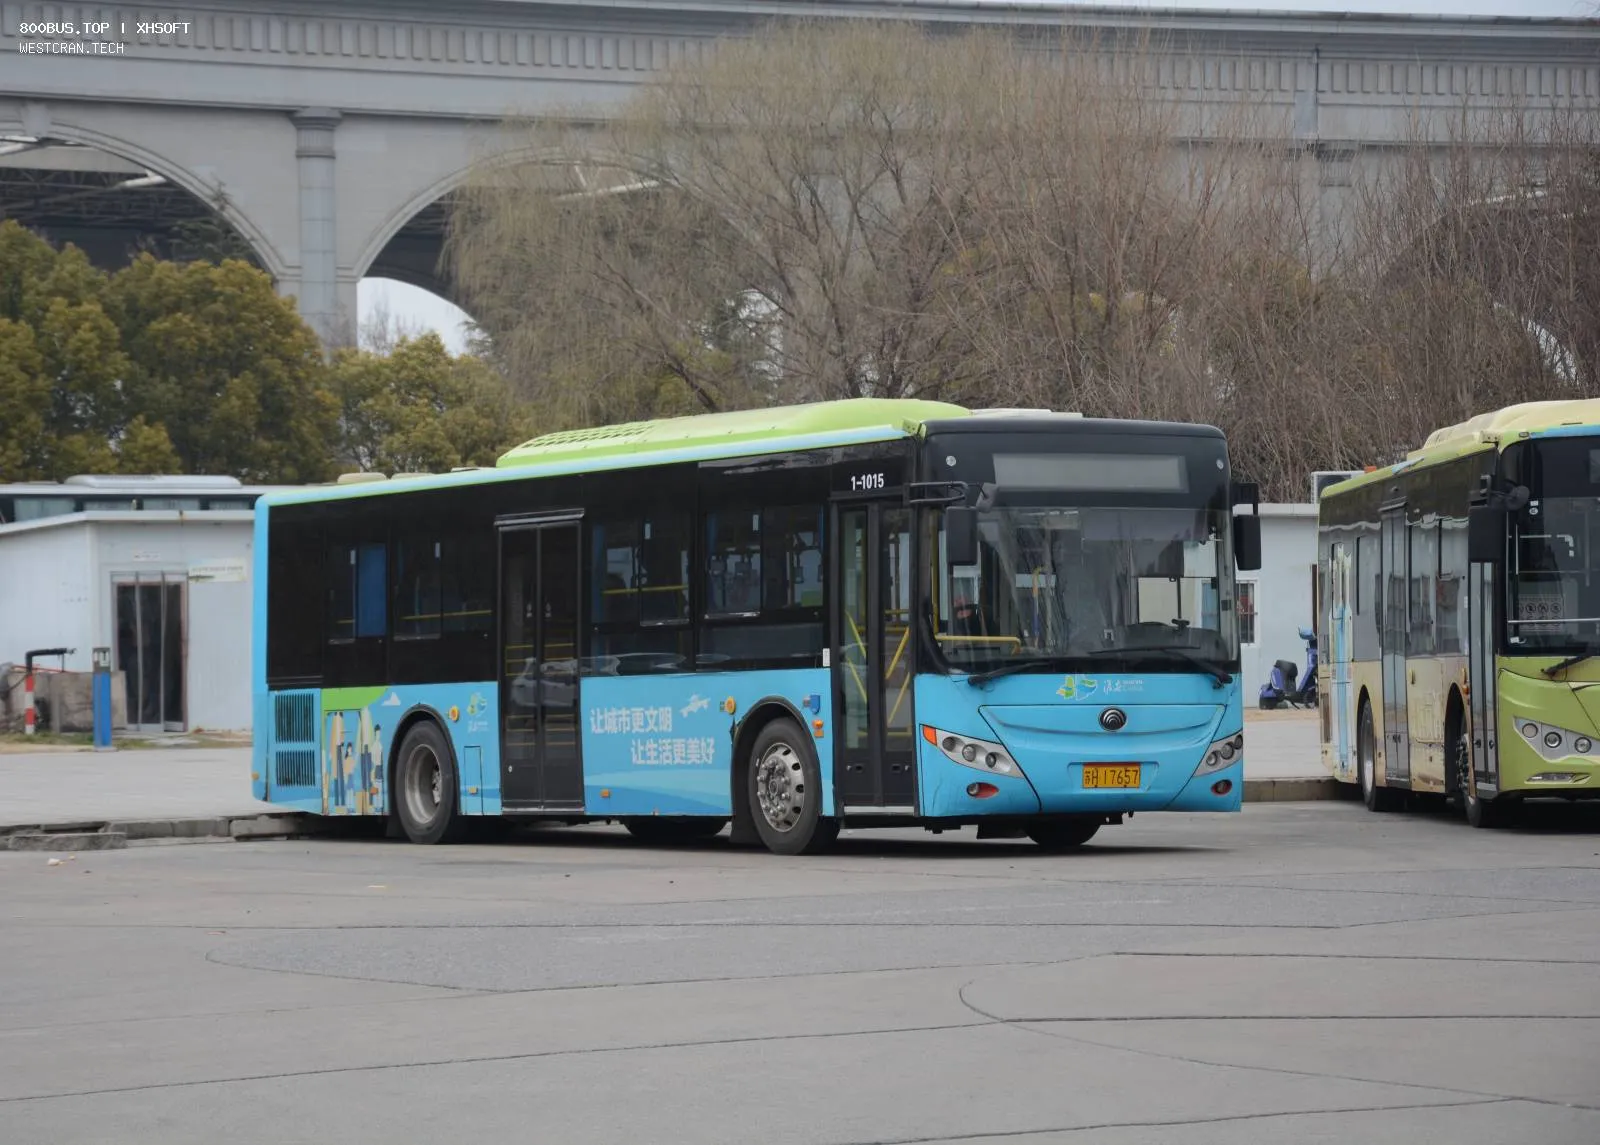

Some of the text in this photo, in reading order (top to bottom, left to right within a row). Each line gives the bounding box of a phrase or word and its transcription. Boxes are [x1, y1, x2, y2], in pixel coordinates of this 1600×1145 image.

[850, 472, 885, 491] 1-1015
[590, 707, 673, 734] 让城市更文明
[631, 737, 715, 765] 让生活更美好
